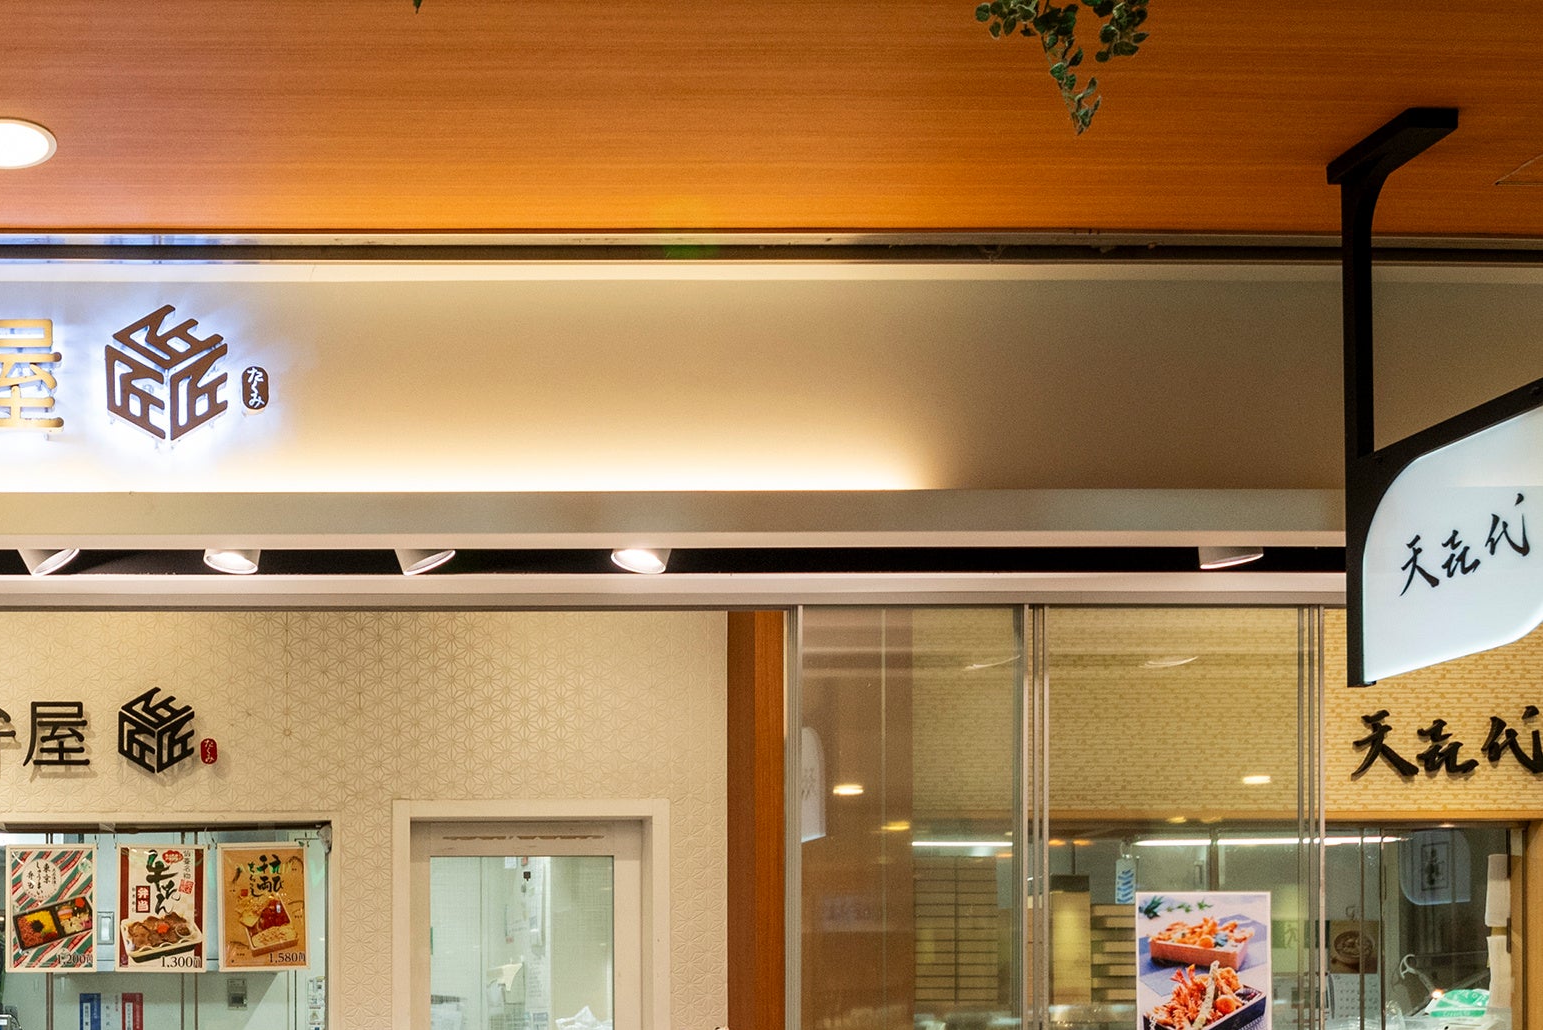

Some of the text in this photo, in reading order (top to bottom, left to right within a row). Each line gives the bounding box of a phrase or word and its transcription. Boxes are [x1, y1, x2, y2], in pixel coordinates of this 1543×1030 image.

[245, 367, 266, 410] たくみ
[202, 738, 215, 765] たくみ
[137, 886, 150, 912] 弁当
[268, 951, 306, 963] 1,580円
